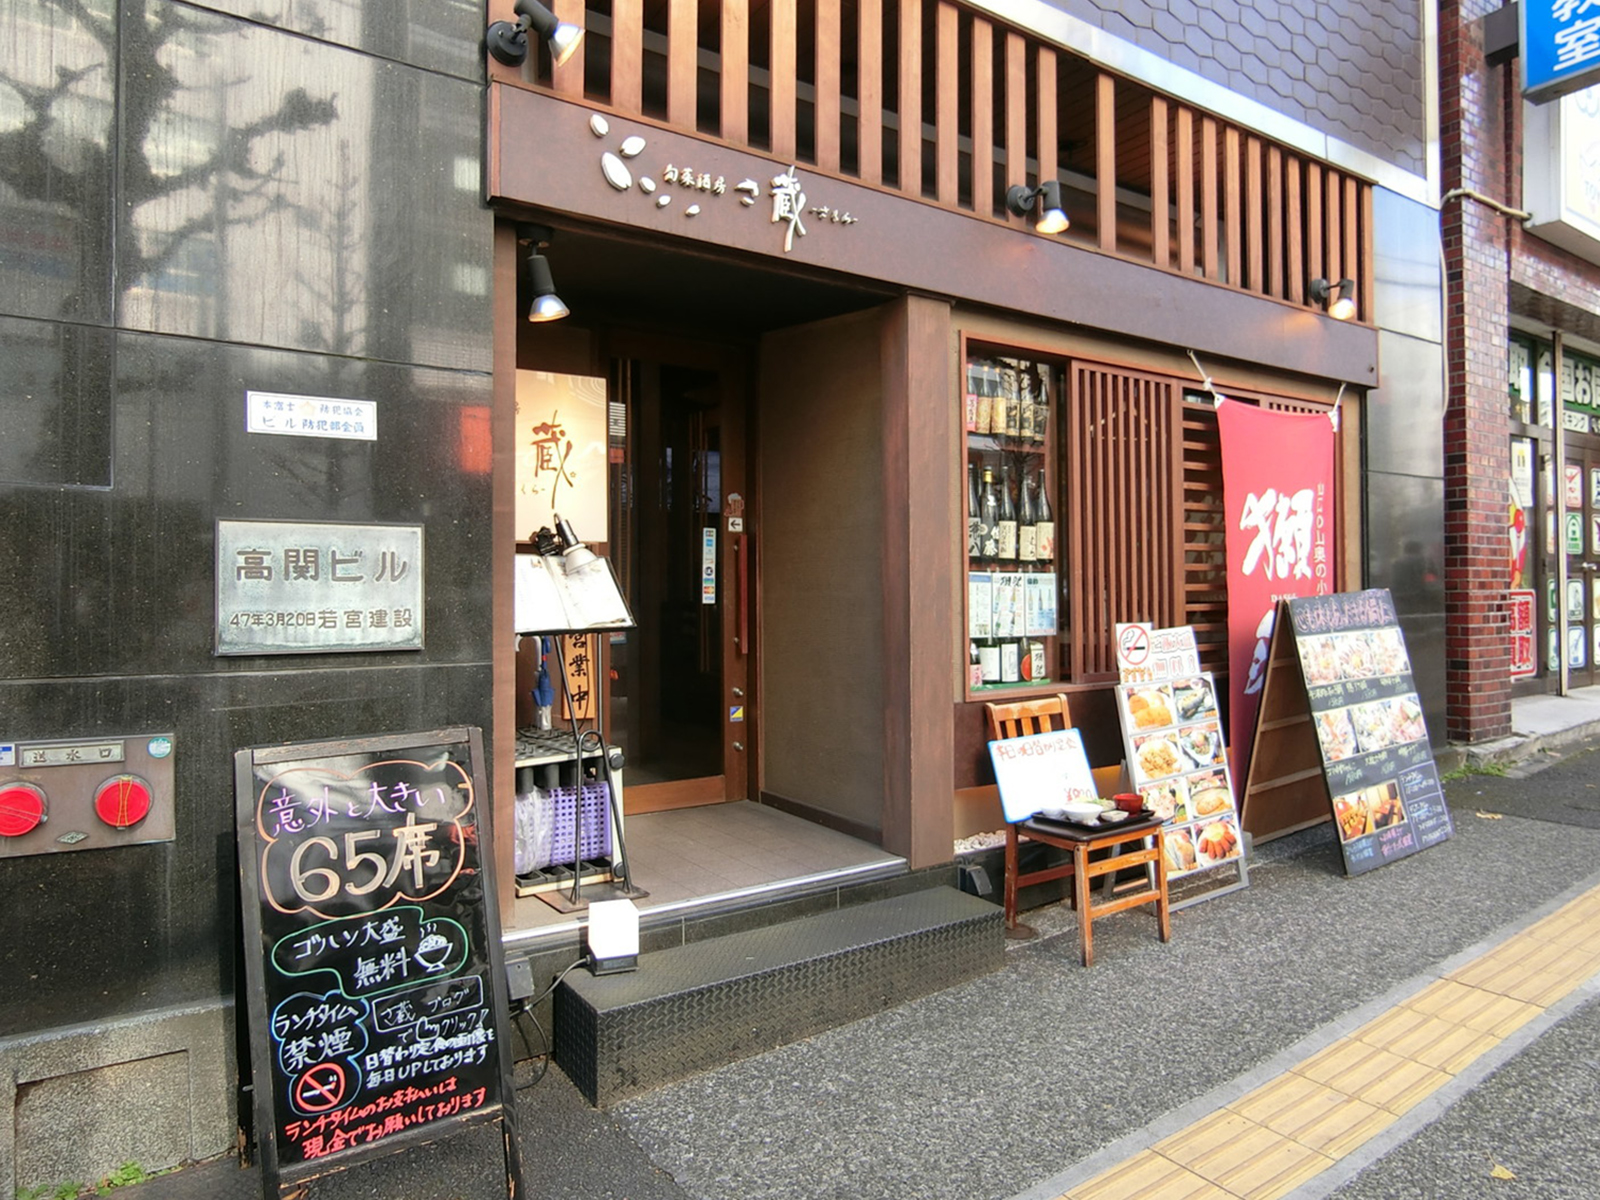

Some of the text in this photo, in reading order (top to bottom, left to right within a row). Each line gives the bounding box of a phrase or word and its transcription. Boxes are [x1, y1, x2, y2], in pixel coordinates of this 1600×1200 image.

[663, 163, 727, 195] 旬菜酒房
[530, 409, 573, 510] 蔵
[235, 549, 408, 583] 高関ビル
[568, 633, 590, 711] 営業中
[268, 781, 446, 837] 意外と大きい
[290, 812, 441, 902] 65席
[353, 946, 411, 989] 無料
[275, 1003, 359, 1036] ランチタイム
[428, 988, 469, 1013] ブログ
[283, 1026, 355, 1072] 禁煙
[366, 1044, 489, 1089] 毎日UPしております
